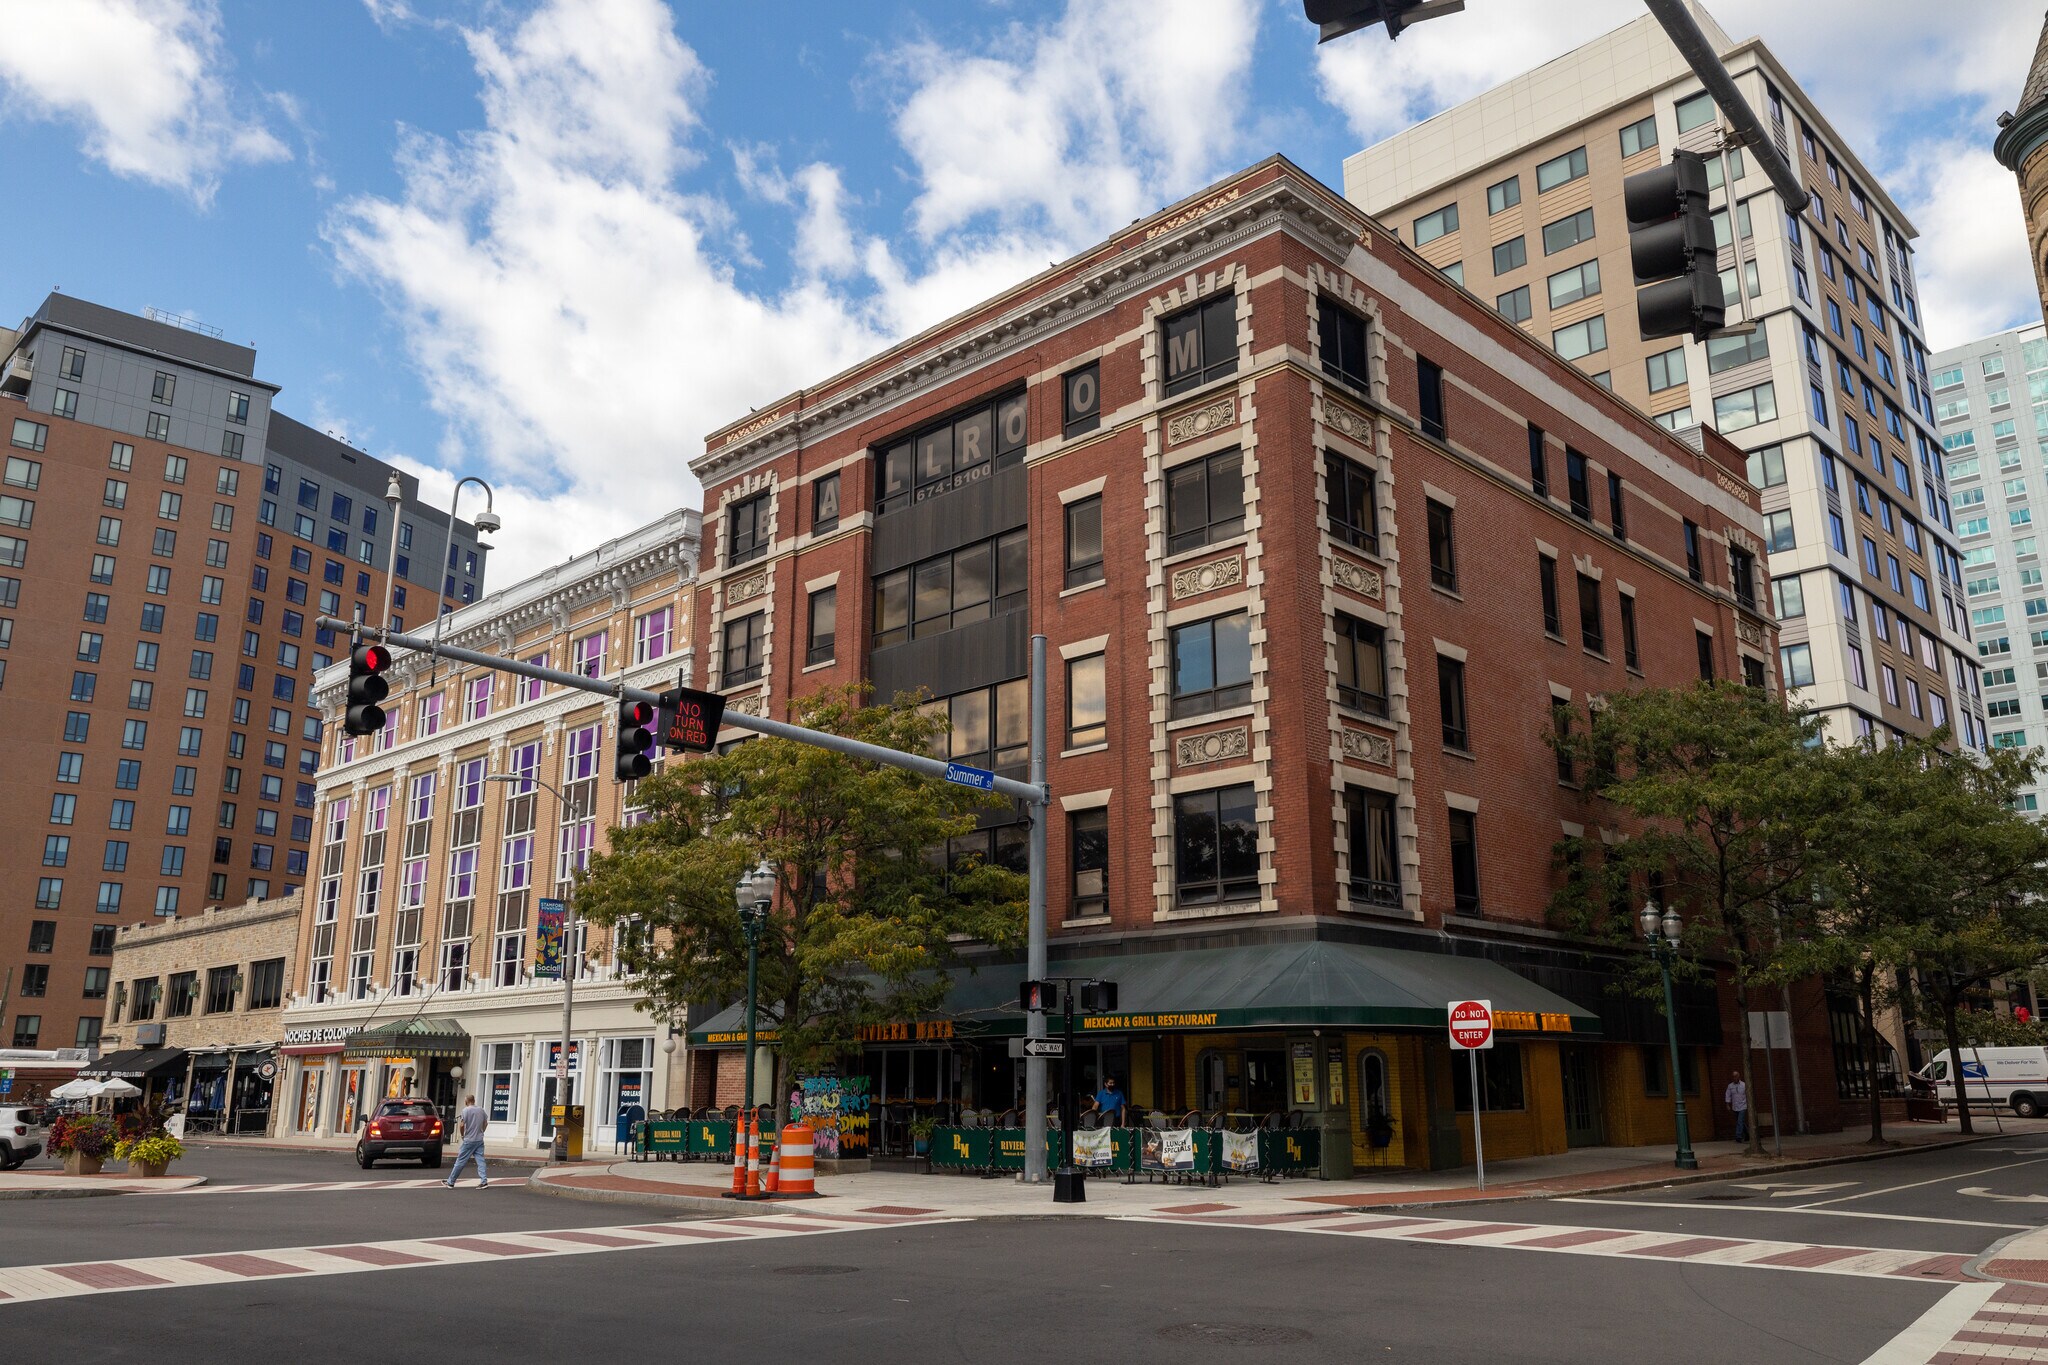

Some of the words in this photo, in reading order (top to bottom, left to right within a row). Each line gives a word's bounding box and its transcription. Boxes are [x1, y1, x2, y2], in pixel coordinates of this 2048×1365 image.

[916, 464, 991, 502] 674-8100
[679, 701, 701, 717] NO
[675, 714, 704, 731] TURN
[669, 727, 684, 740] ON
[686, 730, 707, 744] RED
[947, 766, 984, 786] Summer
[986, 780, 992, 788] St
[1084, 1017, 1122, 1028] MEXICAN
[1123, 1016, 1130, 1027] &
[1132, 1015, 1156, 1027] GRILL
[1157, 1013, 1218, 1026] RESTAURANT
[1455, 1010, 1466, 1019] DO
[1469, 1009, 1485, 1018] NOT
[284, 1029, 311, 1043] NOCHES
[312, 1029, 323, 1041] DE
[916, 1020, 954, 1039] MAYA
[1459, 1031, 1484, 1039] ENTER
[707, 1032, 731, 1043] MEXICAN
[731, 1032, 736, 1042] &
[1000, 1140, 1025, 1150] RIVIER
[1164, 1145, 1191, 1154] SPECIALS
